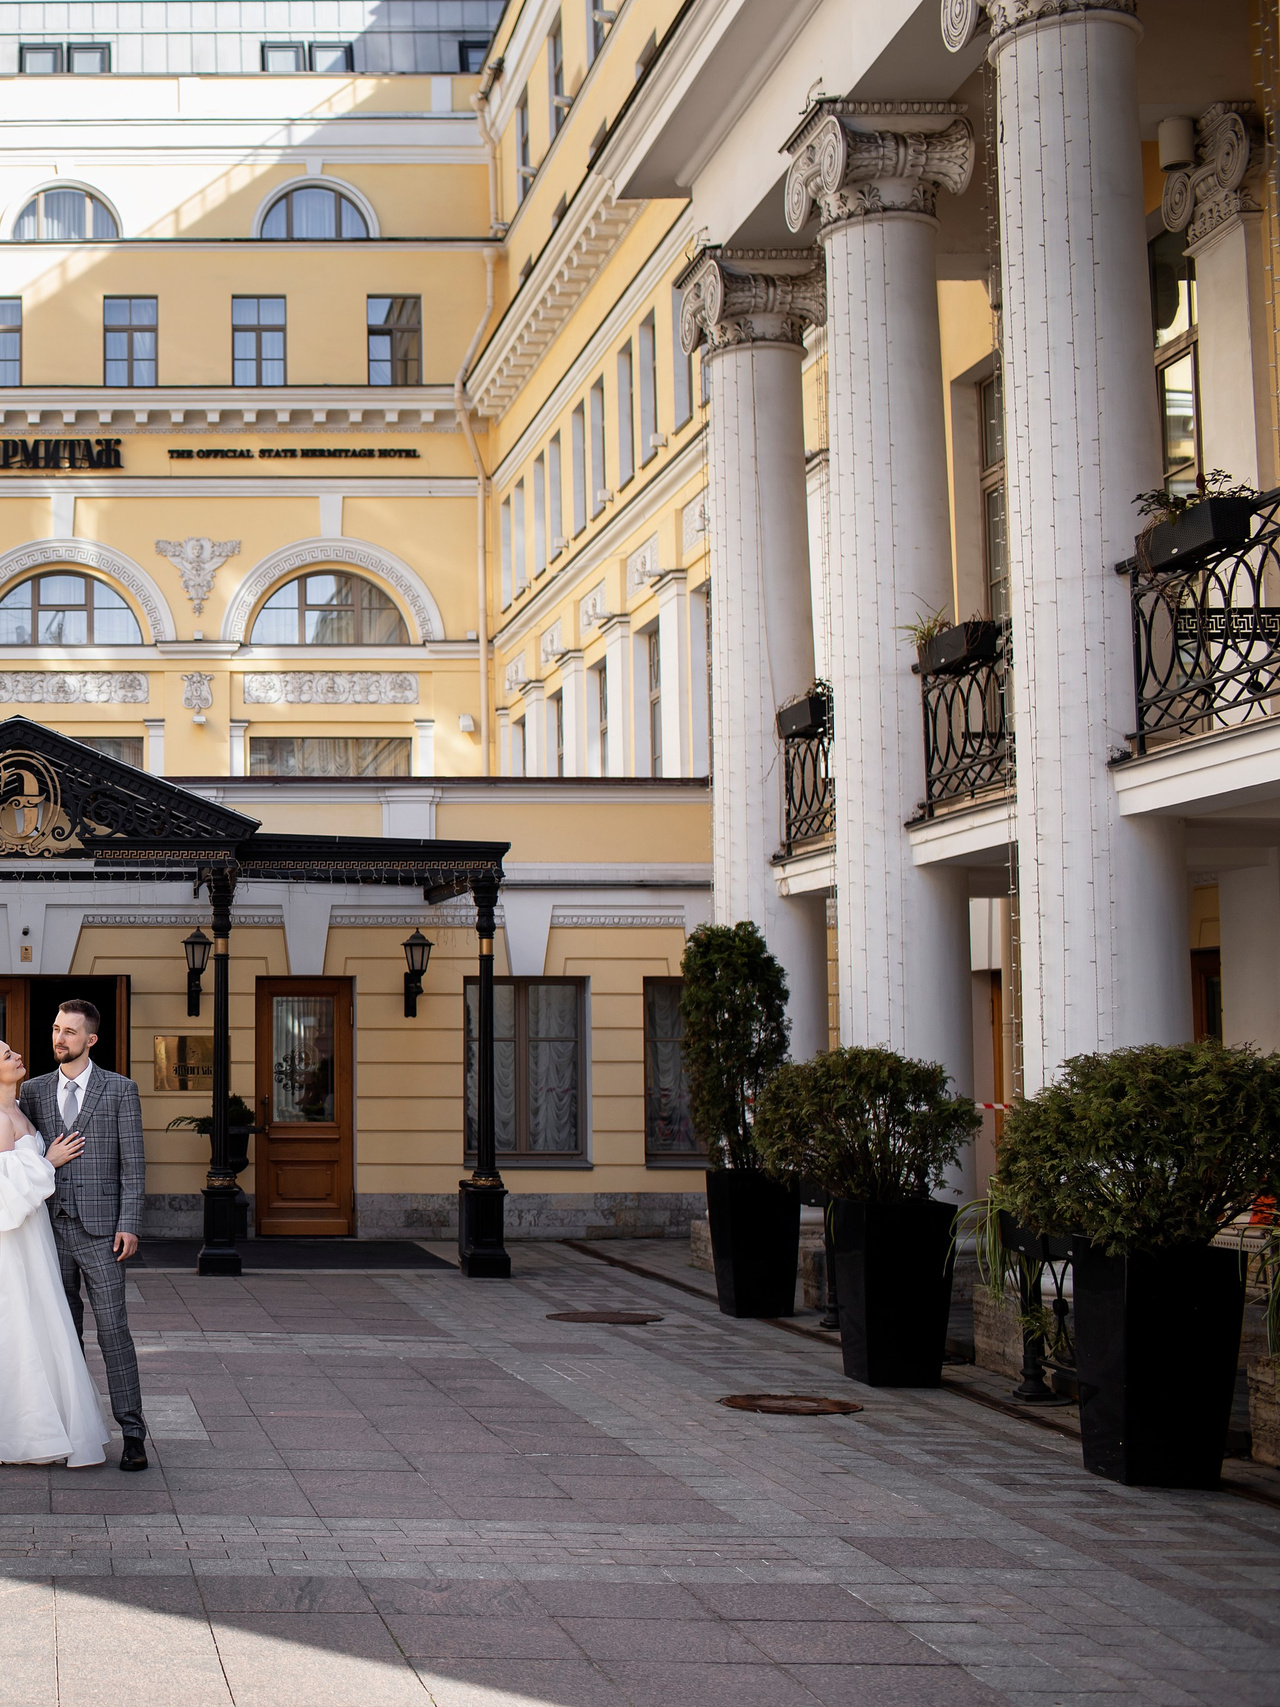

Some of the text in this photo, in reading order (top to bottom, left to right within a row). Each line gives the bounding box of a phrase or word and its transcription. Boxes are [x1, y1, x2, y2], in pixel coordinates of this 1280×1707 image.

[168, 449, 420, 459] THE OFFICIAL STATE HERMITAGE HOTEL
